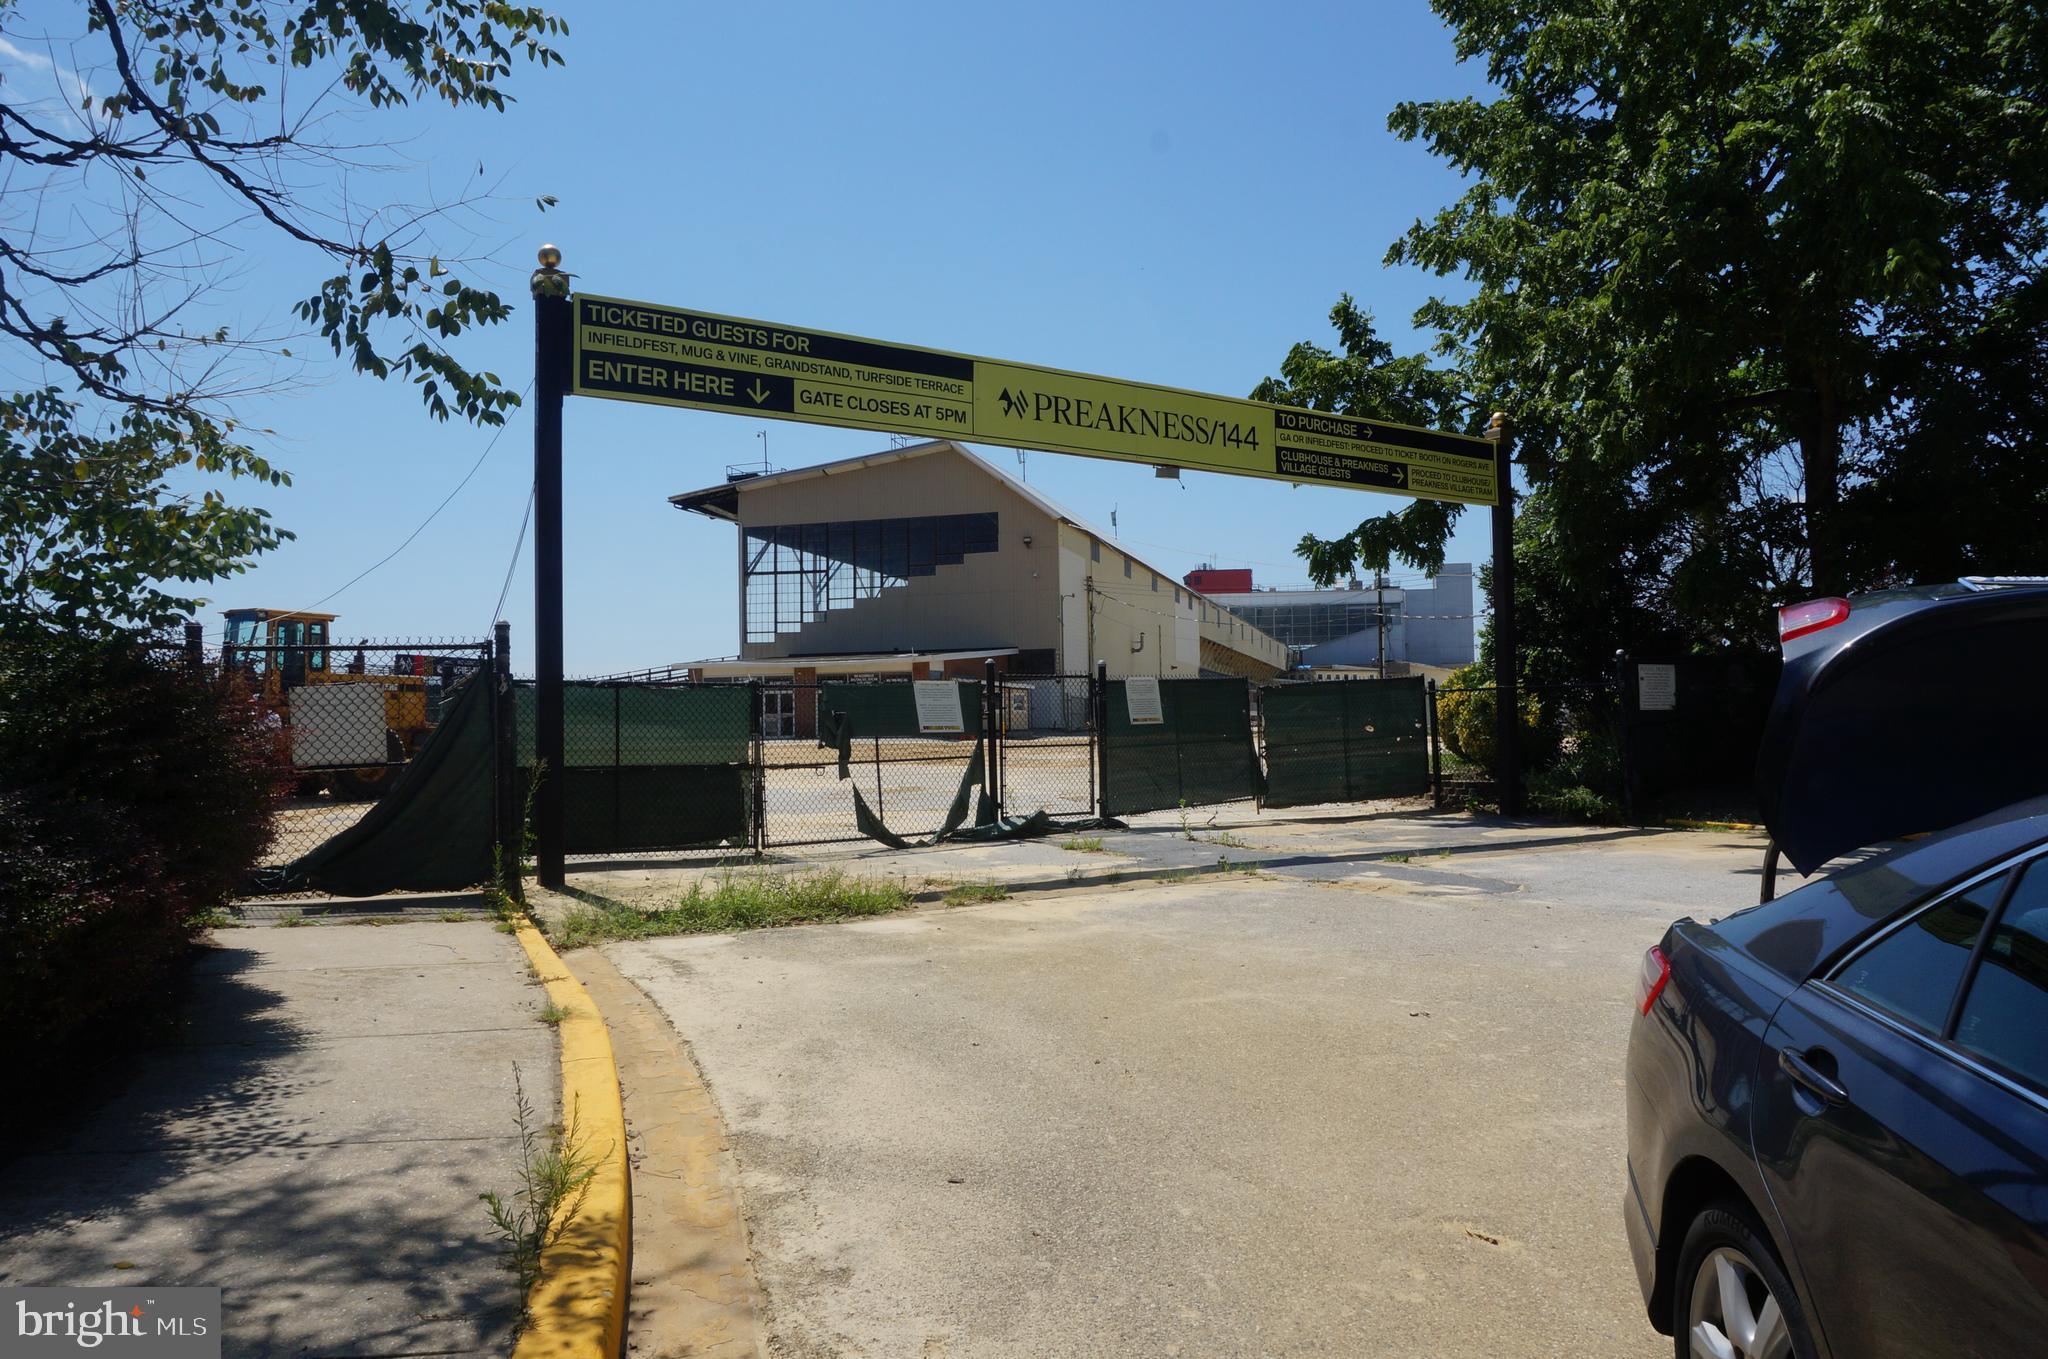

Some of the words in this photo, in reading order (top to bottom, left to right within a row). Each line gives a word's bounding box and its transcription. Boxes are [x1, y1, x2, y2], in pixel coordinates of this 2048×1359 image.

[587, 304, 688, 334] TICKETED
[692, 320, 768, 347] GUESTS
[772, 333, 810, 353] FOR
[588, 331, 678, 356] INFIELDFEST,
[681, 344, 713, 360] MUG
[715, 348, 725, 361] &
[728, 350, 761, 368] VINE,
[764, 356, 853, 381] GRANDSTAND,
[855, 369, 911, 387] TURFSIDE
[914, 378, 964, 395] TERRACE
[588, 361, 667, 391] ENTER
[673, 372, 734, 397] HERE
[800, 389, 843, 408] GATE
[847, 395, 910, 416] CLOSES
[913, 404, 933, 419] AT
[935, 406, 967, 424] 5PM
[1033, 392, 1259, 451] PREAKNESS/144
[1279, 413, 1296, 427] TO
[1298, 415, 1357, 437] PURCHASE
[1280, 432, 1291, 441] GA
[1293, 434, 1304, 444] OR
[1351, 443, 1384, 455] PROCEED
[1385, 448, 1393, 457] TO
[1394, 449, 1418, 460] TICKET
[1419, 453, 1441, 463] BOOTH
[1442, 456, 1451, 465] ON
[1451, 457, 1477, 469] ROGERS
[1280, 450, 1333, 466] CLUBHOUSE
[1334, 457, 1341, 467] &
[1342, 458, 1389, 474] PREAKNESS
[1281, 462, 1317, 475] VILLAGE
[1318, 466, 1351, 479] GUESTS
[1411, 468, 1441, 480] PROCEED
[1443, 471, 1450, 480] TO
[1411, 478, 1448, 491] PREAKNESS
